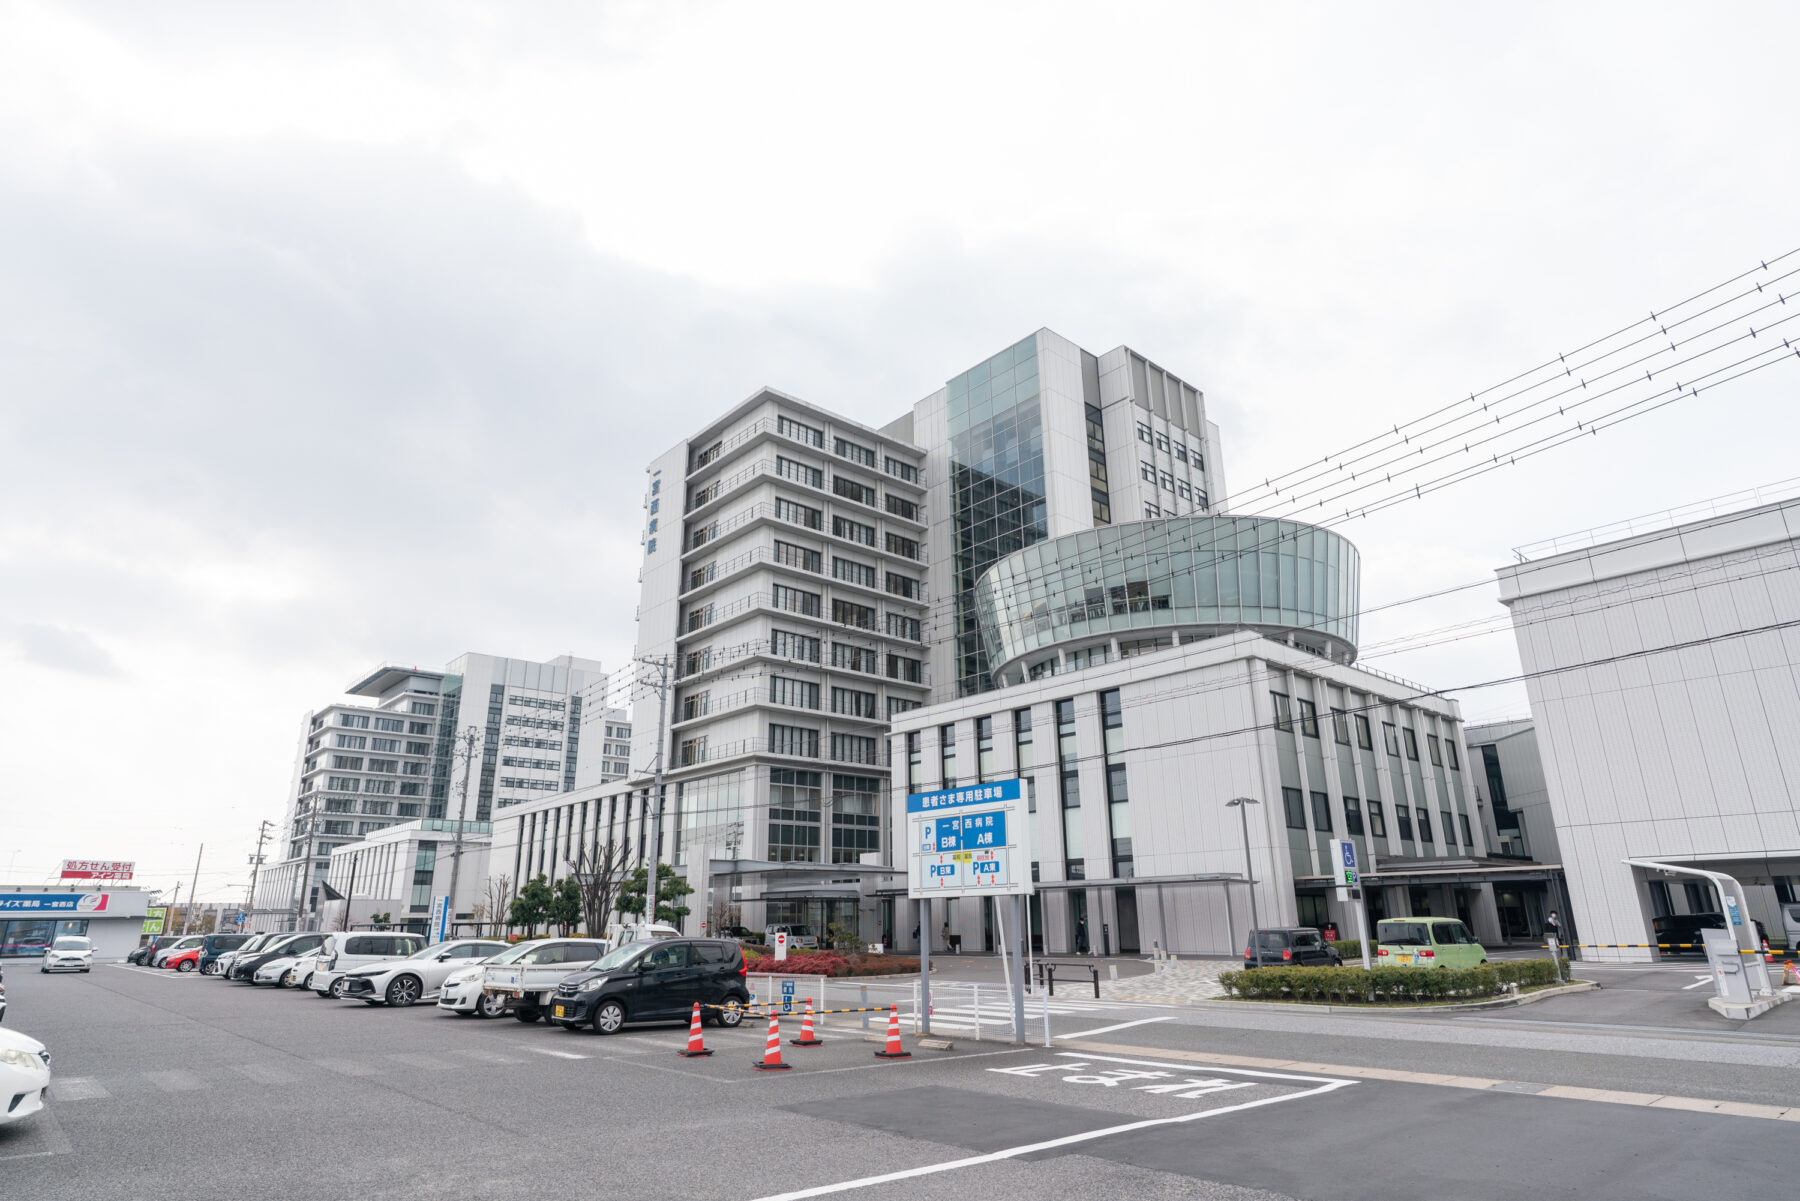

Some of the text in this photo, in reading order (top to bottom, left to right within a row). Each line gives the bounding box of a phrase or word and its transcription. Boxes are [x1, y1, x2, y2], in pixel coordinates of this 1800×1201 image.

[922, 786, 1003, 808] 患者さま専用駐車場
[942, 816, 994, 831] 一宮西病院
[925, 827, 931, 839] P
[977, 832, 993, 845] A棟
[941, 836, 957, 848] B棟
[66, 860, 132, 872] 処方せん受付
[930, 864, 936, 878] P
[973, 861, 979, 875] P
[90, 871, 130, 880] アイン薬局
[984, 1062, 1259, 1099] 止まれ
